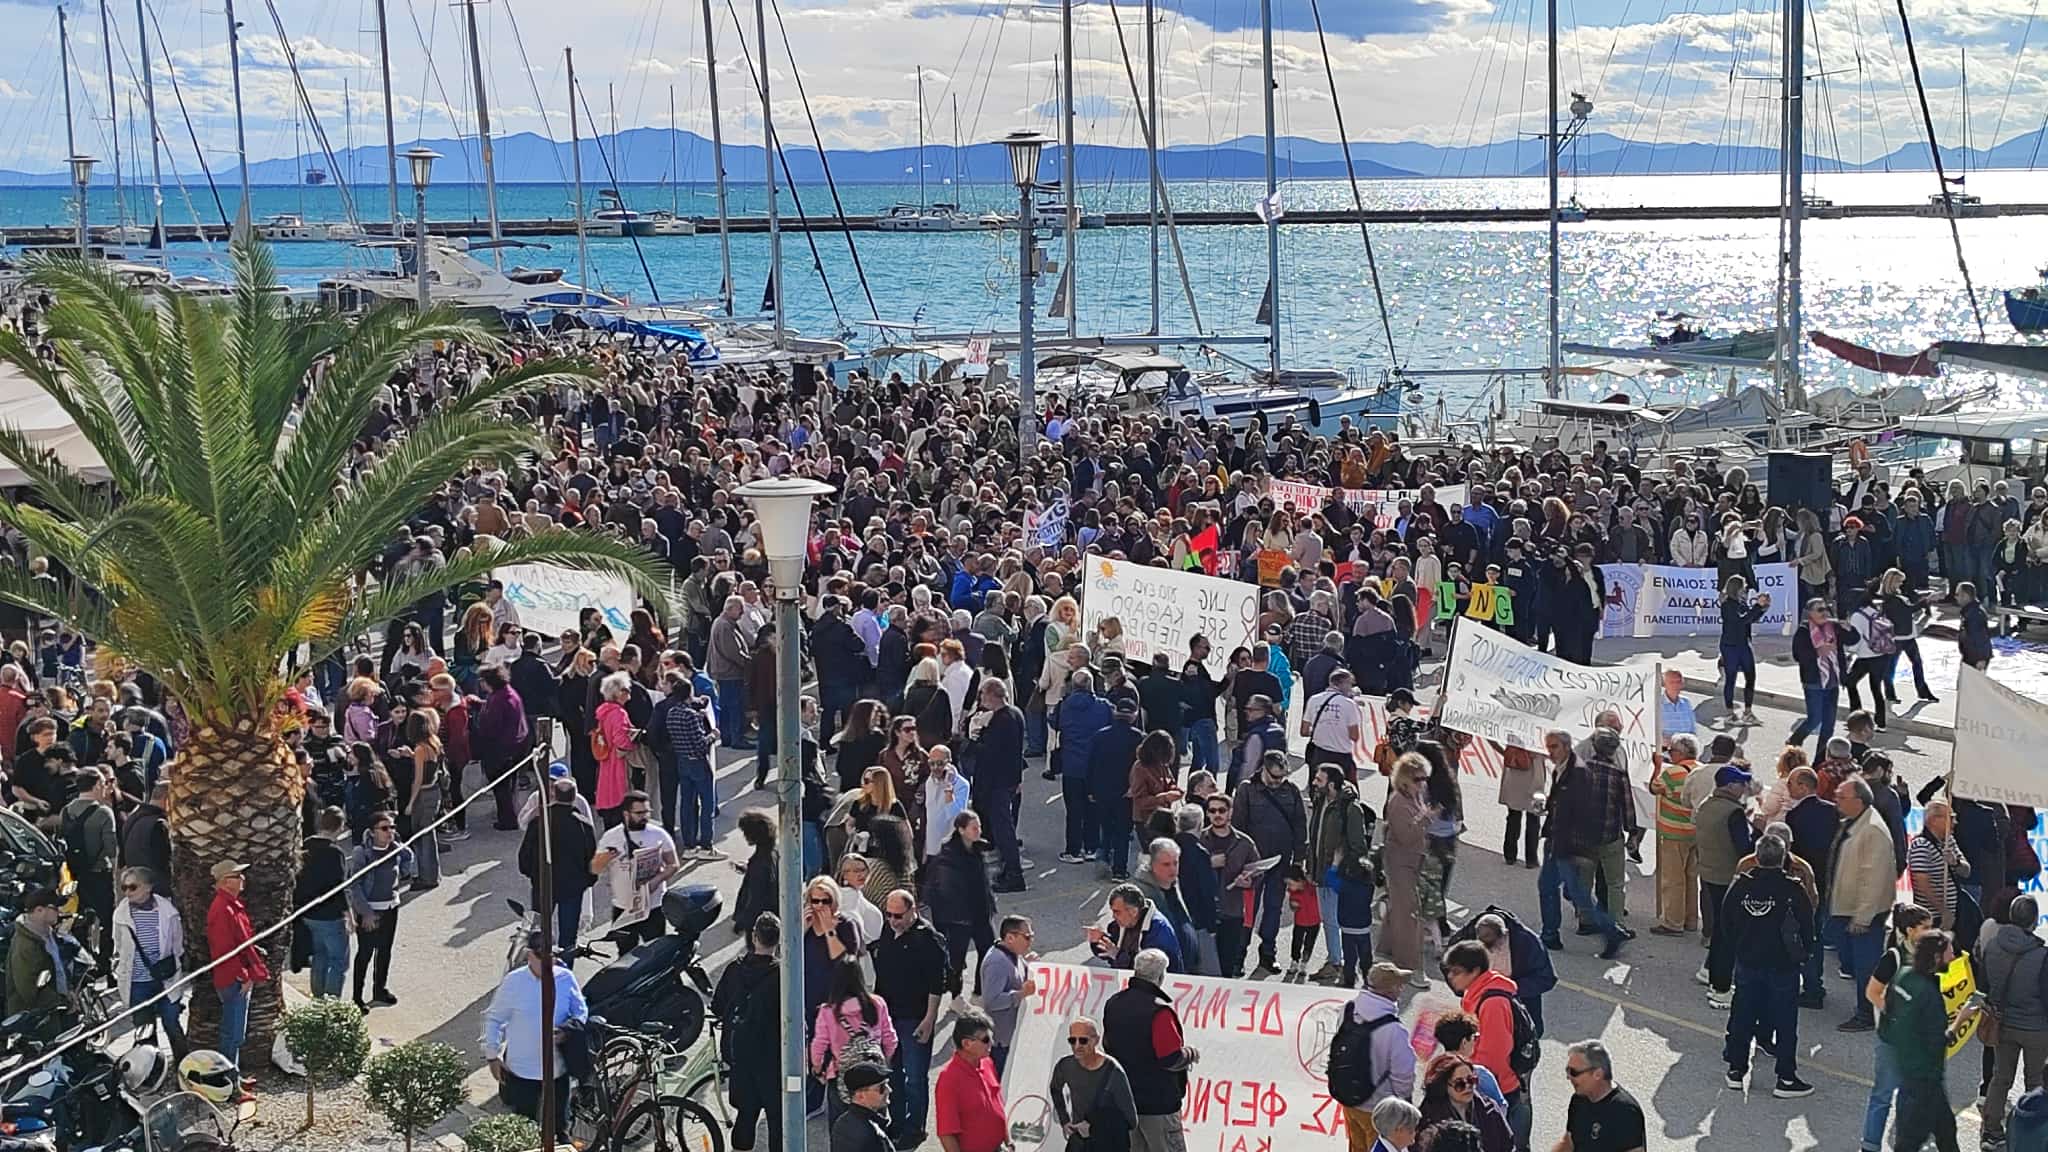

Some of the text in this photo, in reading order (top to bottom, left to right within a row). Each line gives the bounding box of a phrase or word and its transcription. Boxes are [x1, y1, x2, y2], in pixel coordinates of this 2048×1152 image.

[1653, 576, 1707, 590] ΕΝΙΑΙΟΣ
[1711, 575, 1785, 589] ΣΓΟΣ
[1643, 614, 1723, 625] ΠΑΝΕΠΙΣΤΗΜΙΟ
